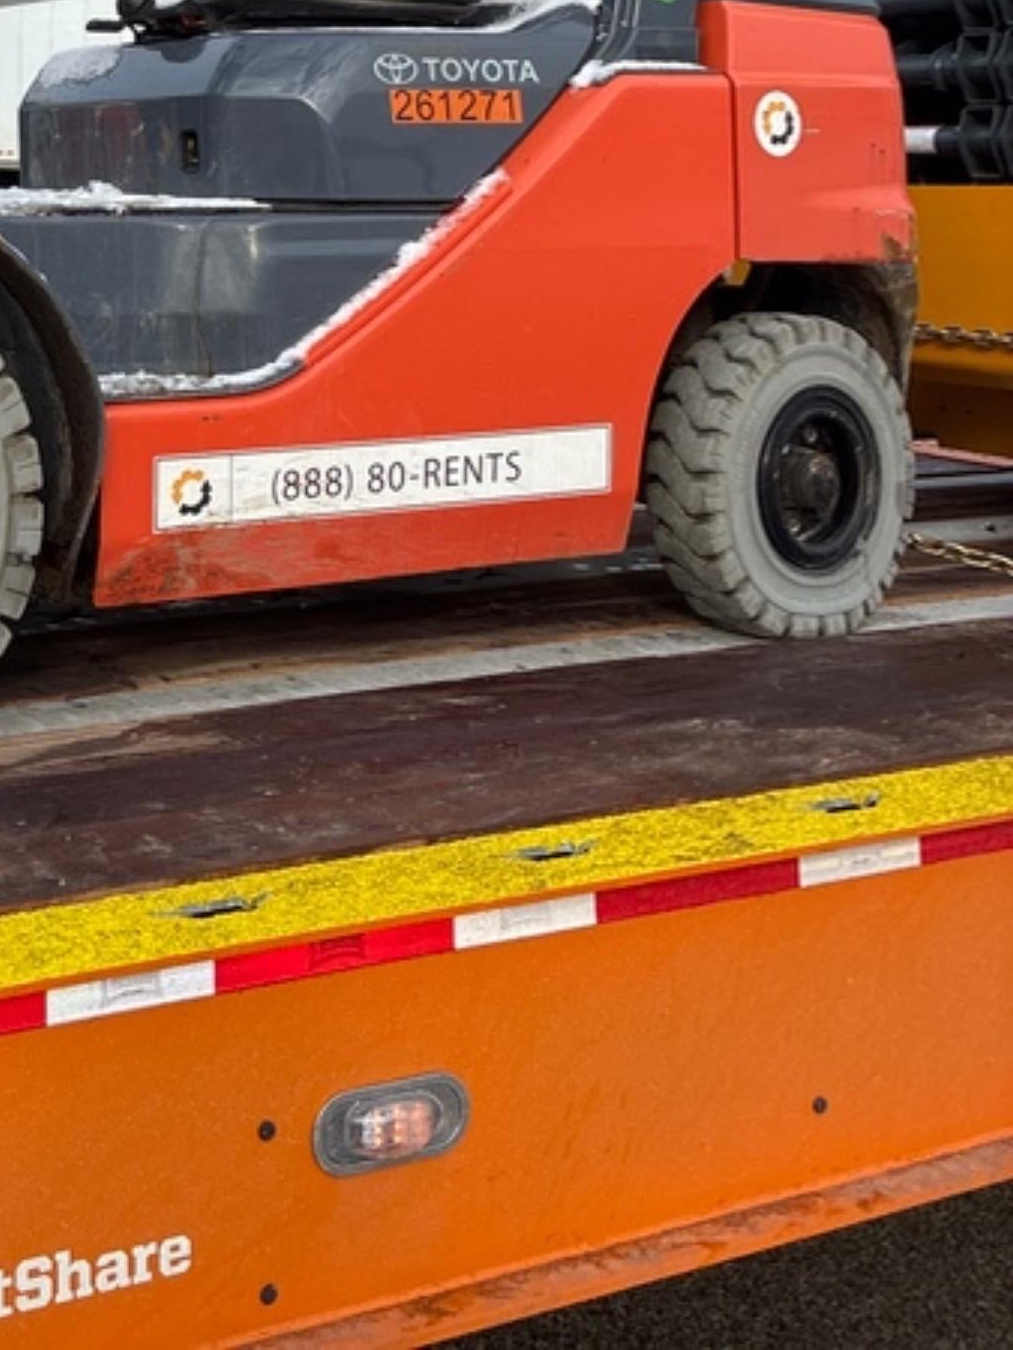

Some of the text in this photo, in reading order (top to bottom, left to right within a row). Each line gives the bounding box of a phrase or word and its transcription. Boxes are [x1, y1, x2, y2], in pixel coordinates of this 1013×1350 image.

[421, 56, 540, 83] TOYOTA
[393, 90, 516, 121] 261271
[271, 451, 523, 507] (888) 80-RENTS
